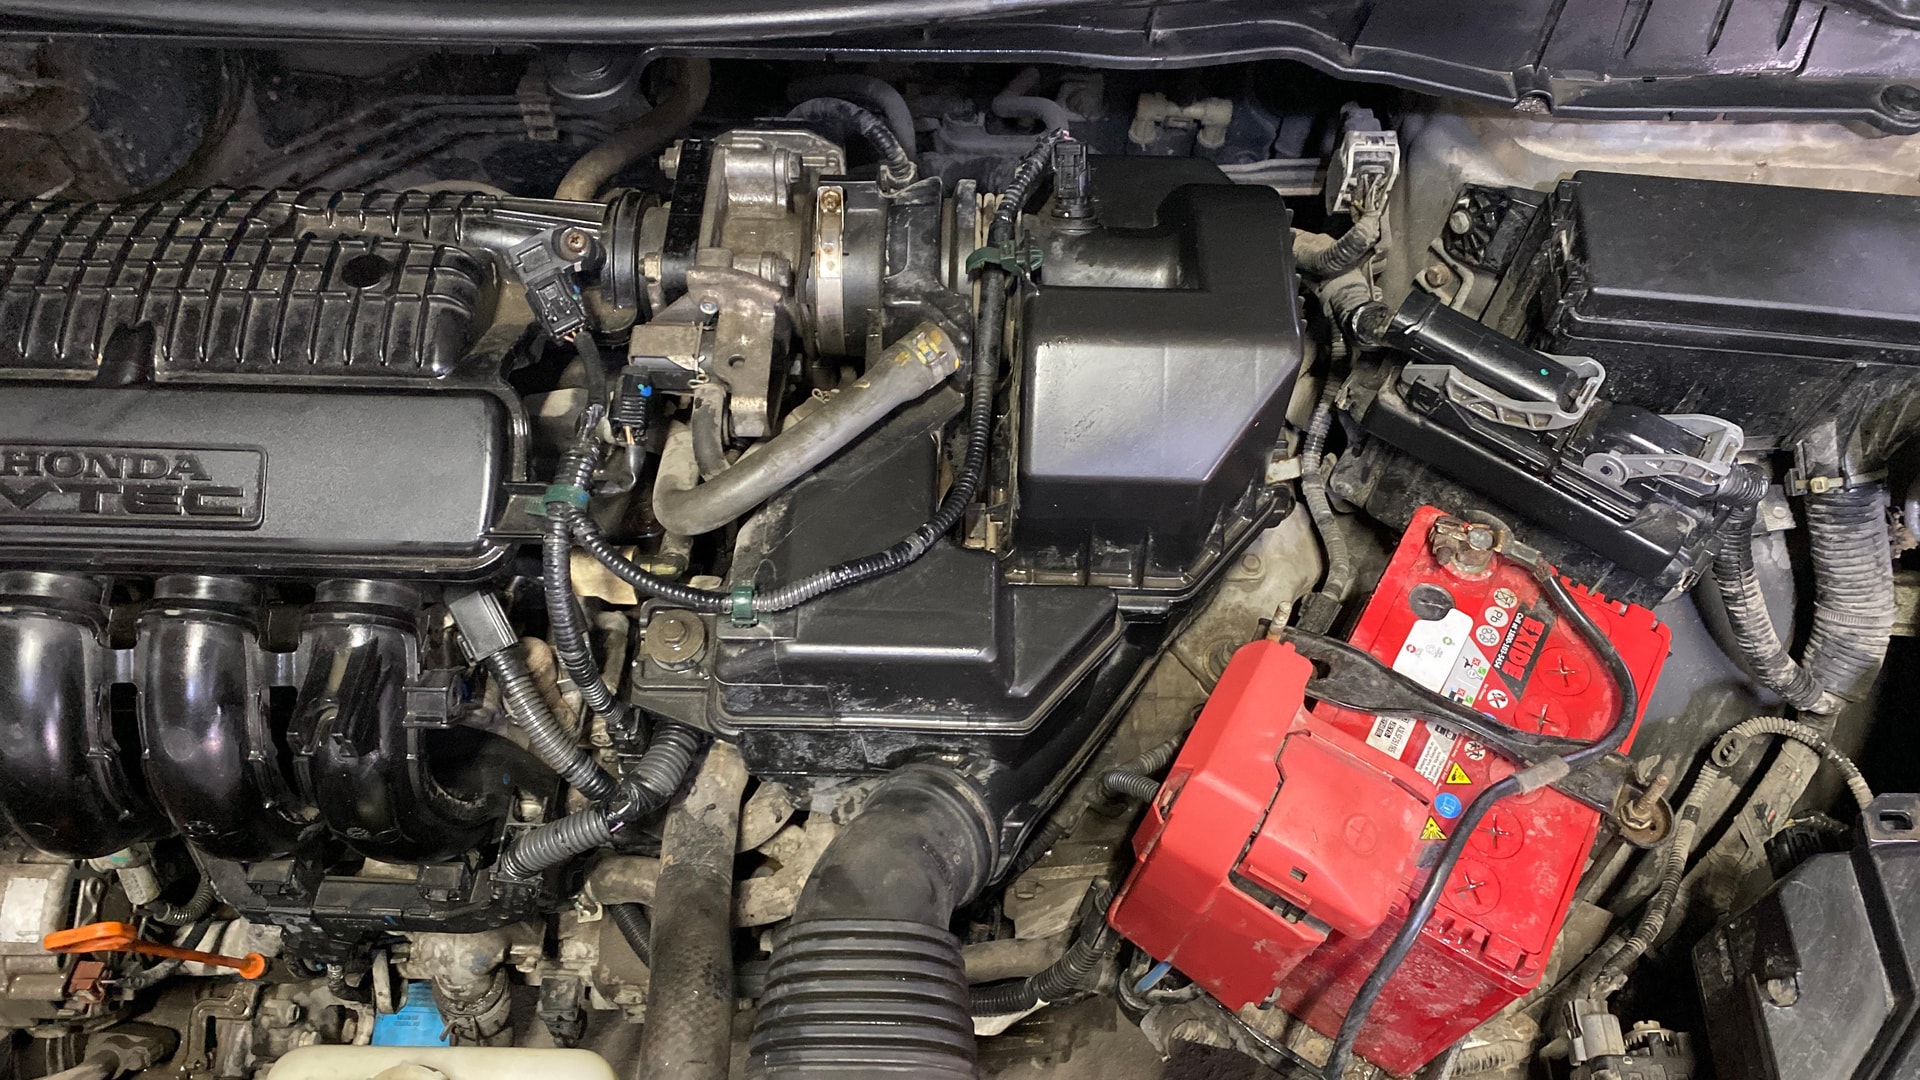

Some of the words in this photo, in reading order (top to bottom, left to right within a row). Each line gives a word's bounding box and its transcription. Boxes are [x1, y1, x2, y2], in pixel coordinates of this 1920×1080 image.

[1, 451, 212, 481] HONDA
[0, 484, 243, 516] VTEC
[1490, 609, 1503, 623] Pb
[1513, 611, 1524, 624] Call
[1501, 616, 1545, 681] EXIDE
